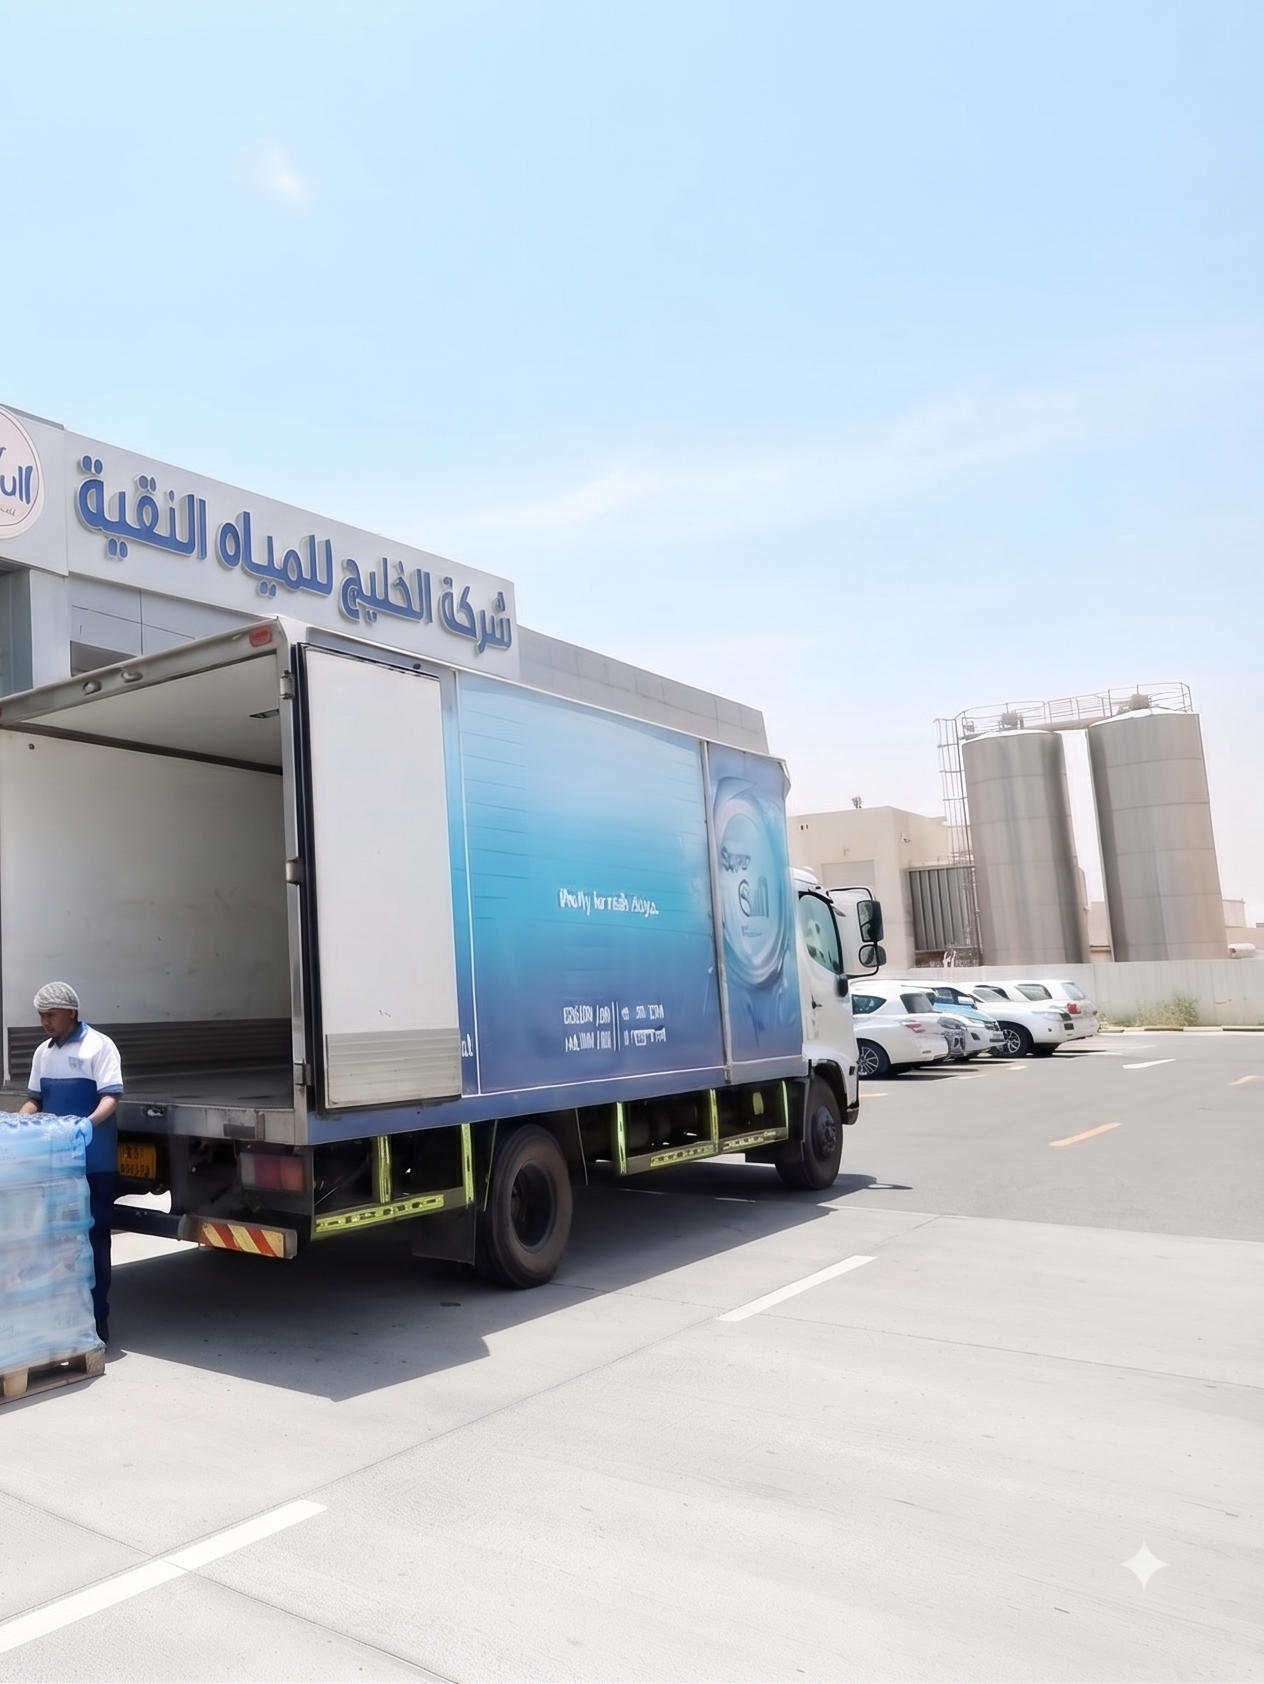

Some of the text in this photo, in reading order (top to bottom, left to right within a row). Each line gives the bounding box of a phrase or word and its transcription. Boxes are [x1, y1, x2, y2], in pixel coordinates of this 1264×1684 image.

[76, 453, 512, 655] شركة الخليج للمياه النقية
